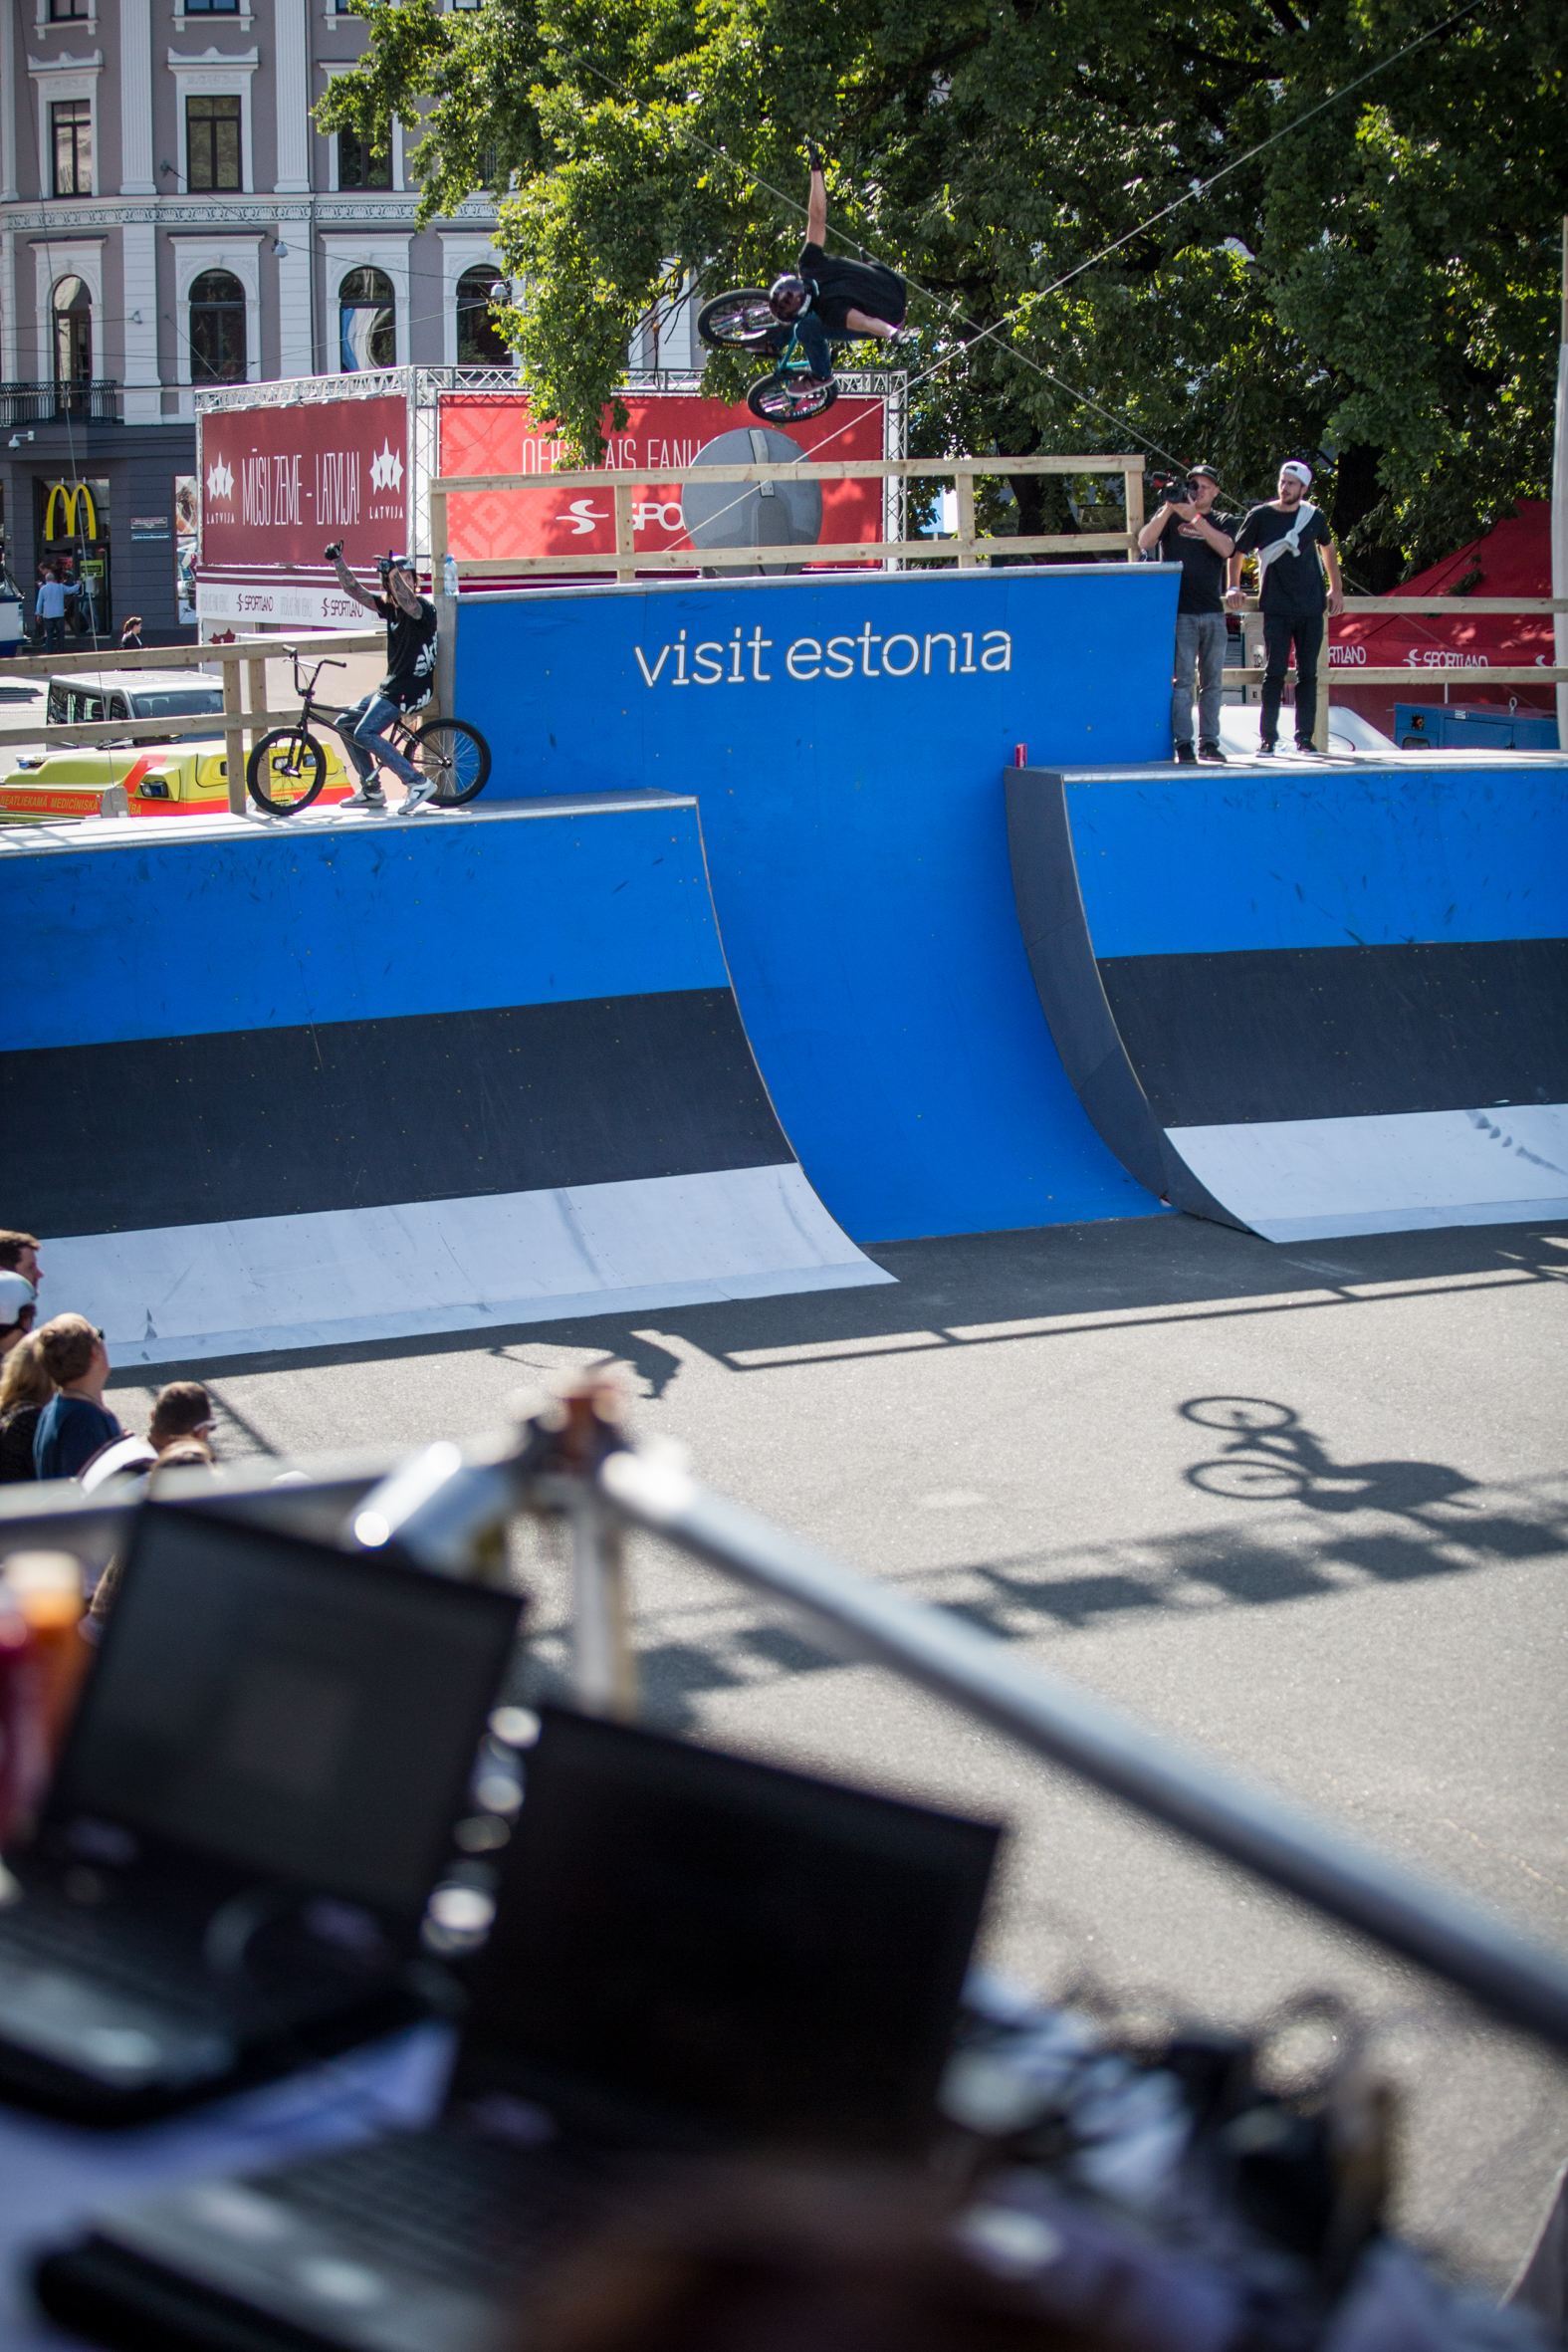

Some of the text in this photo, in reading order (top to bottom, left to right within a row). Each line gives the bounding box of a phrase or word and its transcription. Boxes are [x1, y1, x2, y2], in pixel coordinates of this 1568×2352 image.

[242, 448, 271, 526] MŪSU
[274, 454, 303, 526] ZEME
[316, 451, 360, 525] LATVIJA!
[206, 512, 235, 525] LATVIJA
[369, 505, 404, 520] LATVIJA
[244, 595, 274, 612] SPORTLAND
[331, 599, 364, 618] SPORTLAND
[634, 621, 1012, 687] visit estonia
[1, 795, 48, 808] NEATLIEKAMĀ
